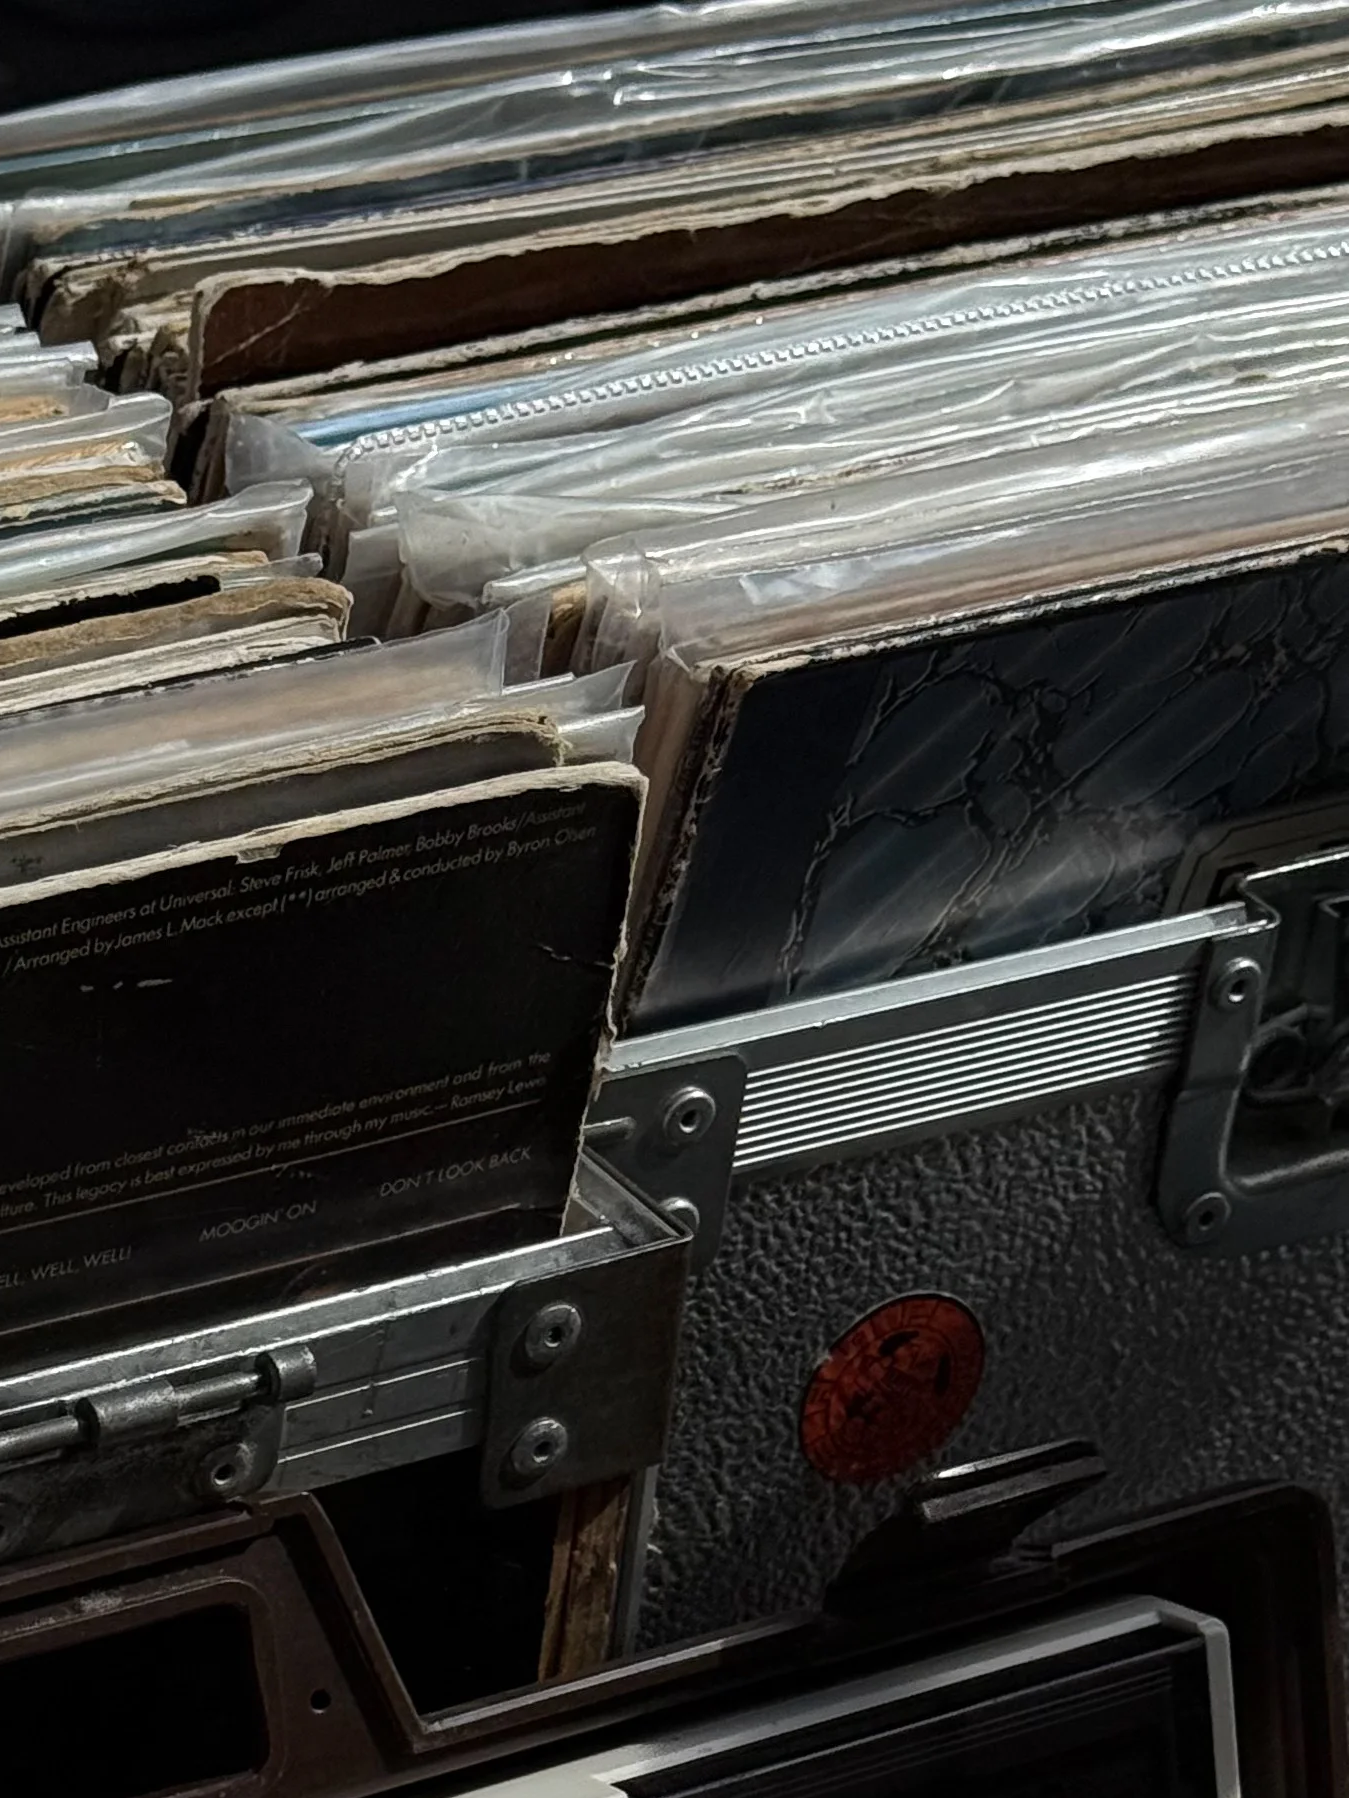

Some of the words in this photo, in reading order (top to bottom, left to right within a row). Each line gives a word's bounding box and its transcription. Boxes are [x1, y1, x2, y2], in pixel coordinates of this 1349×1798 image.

[61, 907, 136, 934] Engineers
[139, 900, 156, 916] at
[239, 874, 281, 892] Steve
[326, 851, 355, 873] Jeff
[415, 829, 464, 851] Bobby
[93, 937, 112, 955] by
[111, 927, 162, 949] James
[179, 909, 222, 932] Mack
[225, 897, 278, 921] except
[314, 870, 387, 901] arranged
[385, 868, 400, 884] &
[402, 849, 481, 880] conducted
[480, 847, 503, 862] by
[506, 837, 550, 857] Byron
[438, 1158, 483, 1182] LOOK
[488, 1147, 530, 1168] BACK
[286, 1200, 316, 1219] ON
